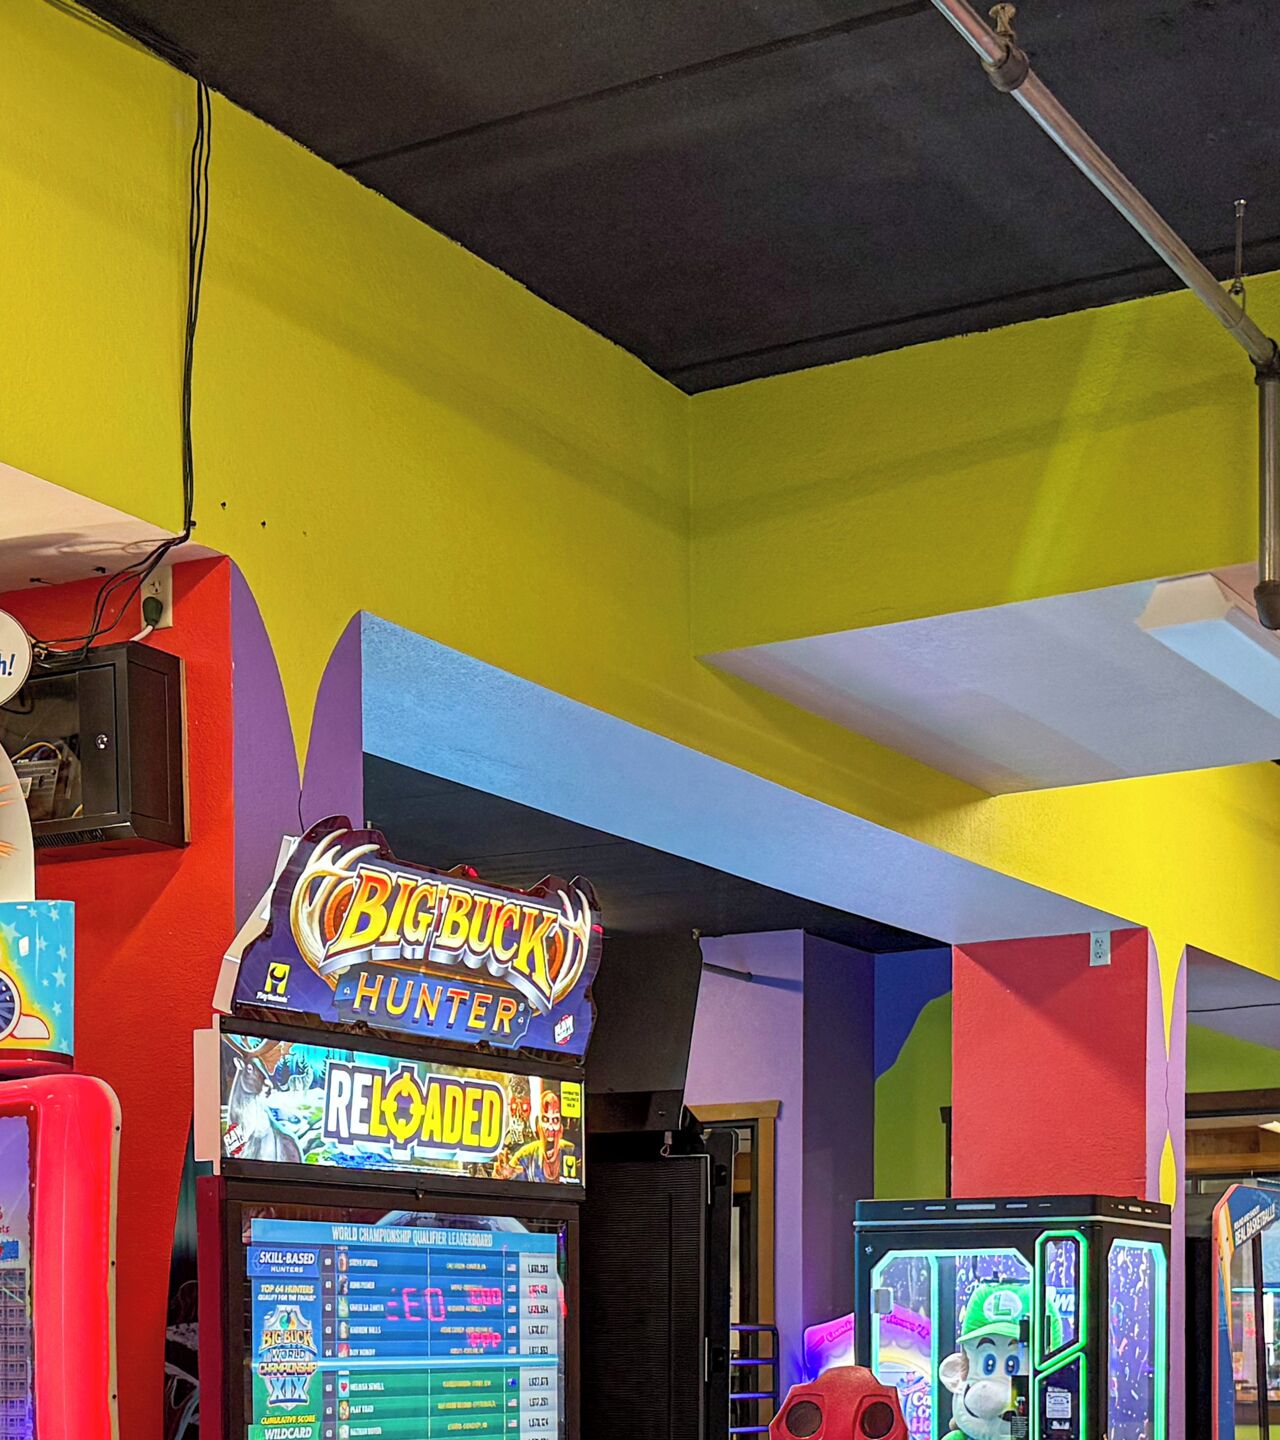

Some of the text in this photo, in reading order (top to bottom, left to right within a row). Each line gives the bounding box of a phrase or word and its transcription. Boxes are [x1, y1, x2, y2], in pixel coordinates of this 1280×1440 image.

[328, 868, 557, 997] BIG BUCK
[353, 972, 518, 1034] HUNTER
[328, 1068, 503, 1148] RELOADED
[332, 1226, 493, 1247] WORLD CHAMPIONSHIP QUALIFIER LEADERBOARD
[260, 1252, 315, 1265] SKILL-BASED
[993, 1295, 1011, 1316] L
[263, 1330, 313, 1348] BIG BUCK
[272, 1350, 306, 1360] WORLD
[270, 1377, 308, 1401] XIX
[265, 1427, 312, 1440] WILDCARD
